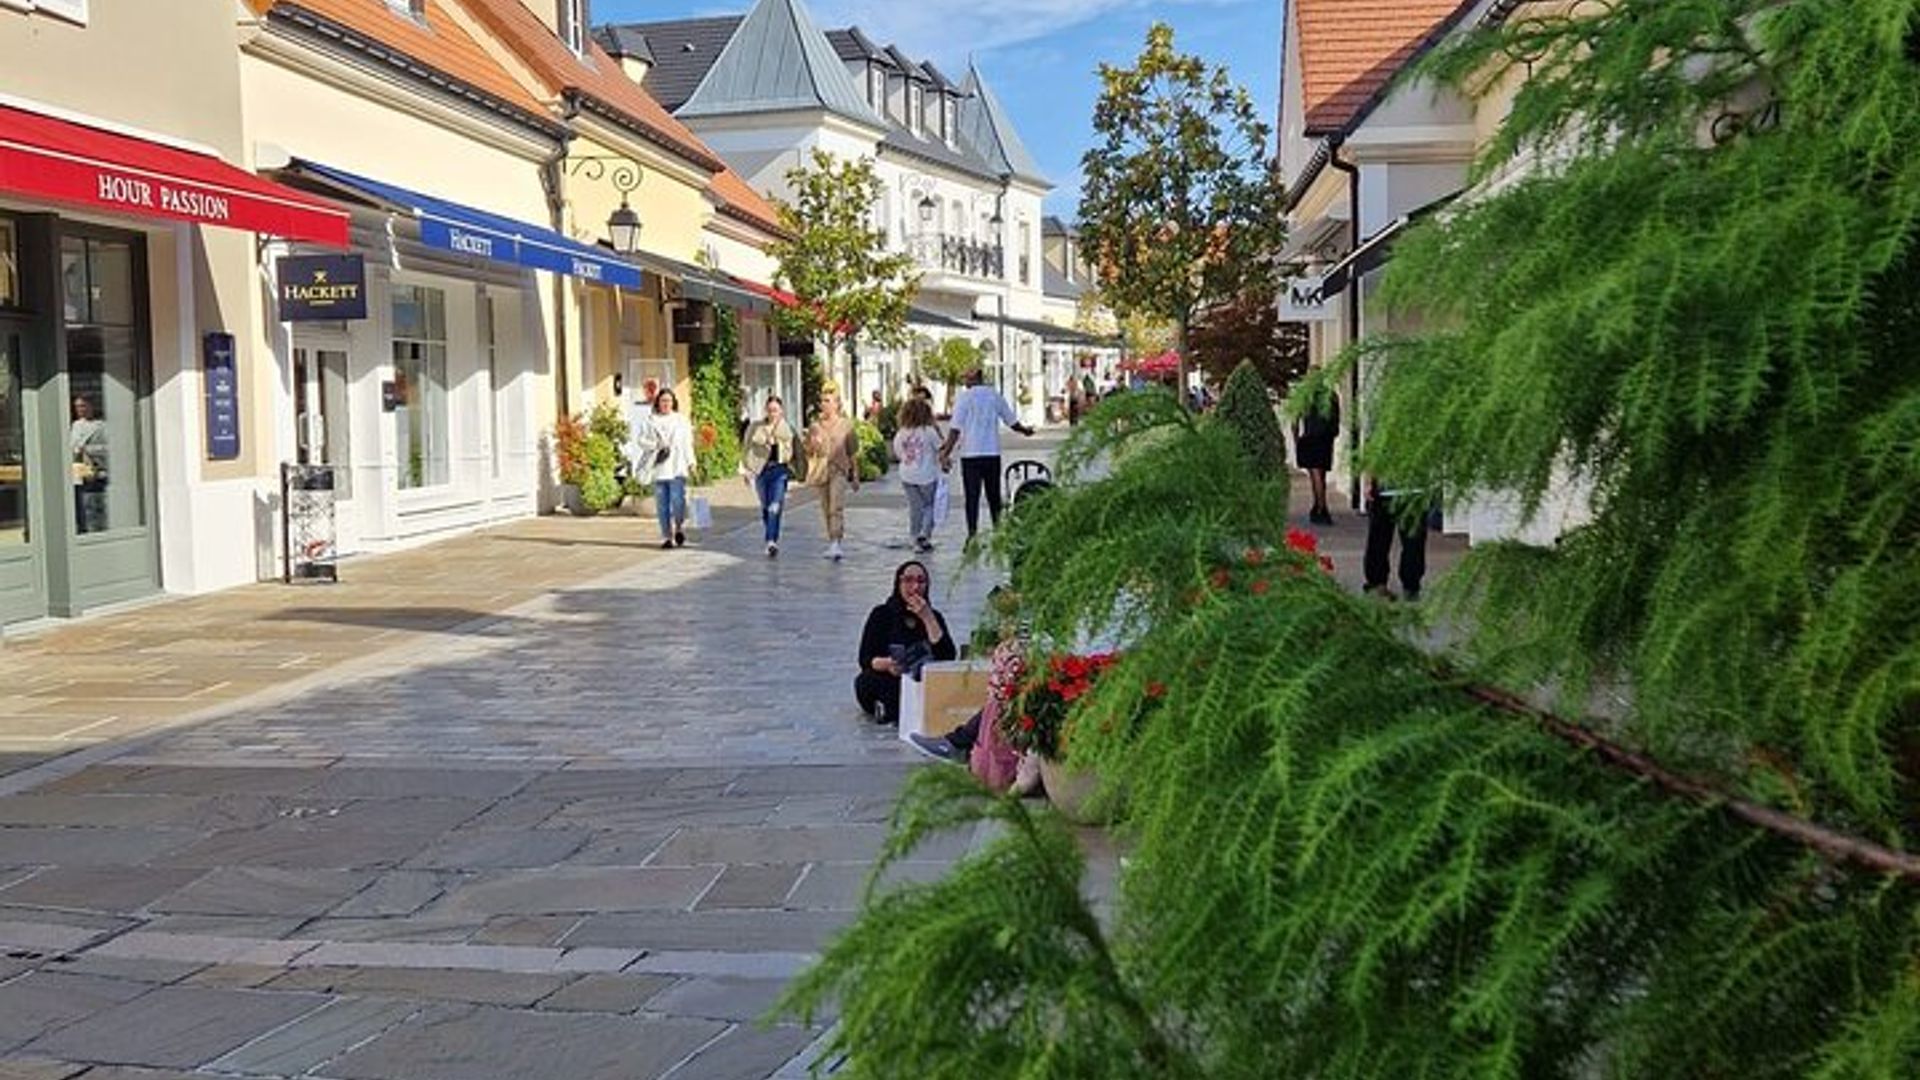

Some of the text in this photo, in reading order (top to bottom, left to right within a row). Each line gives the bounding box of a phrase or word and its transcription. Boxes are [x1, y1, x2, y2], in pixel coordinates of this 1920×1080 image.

[98, 174, 228, 219] HOUR PASSION
[285, 285, 358, 300] HACKETT
